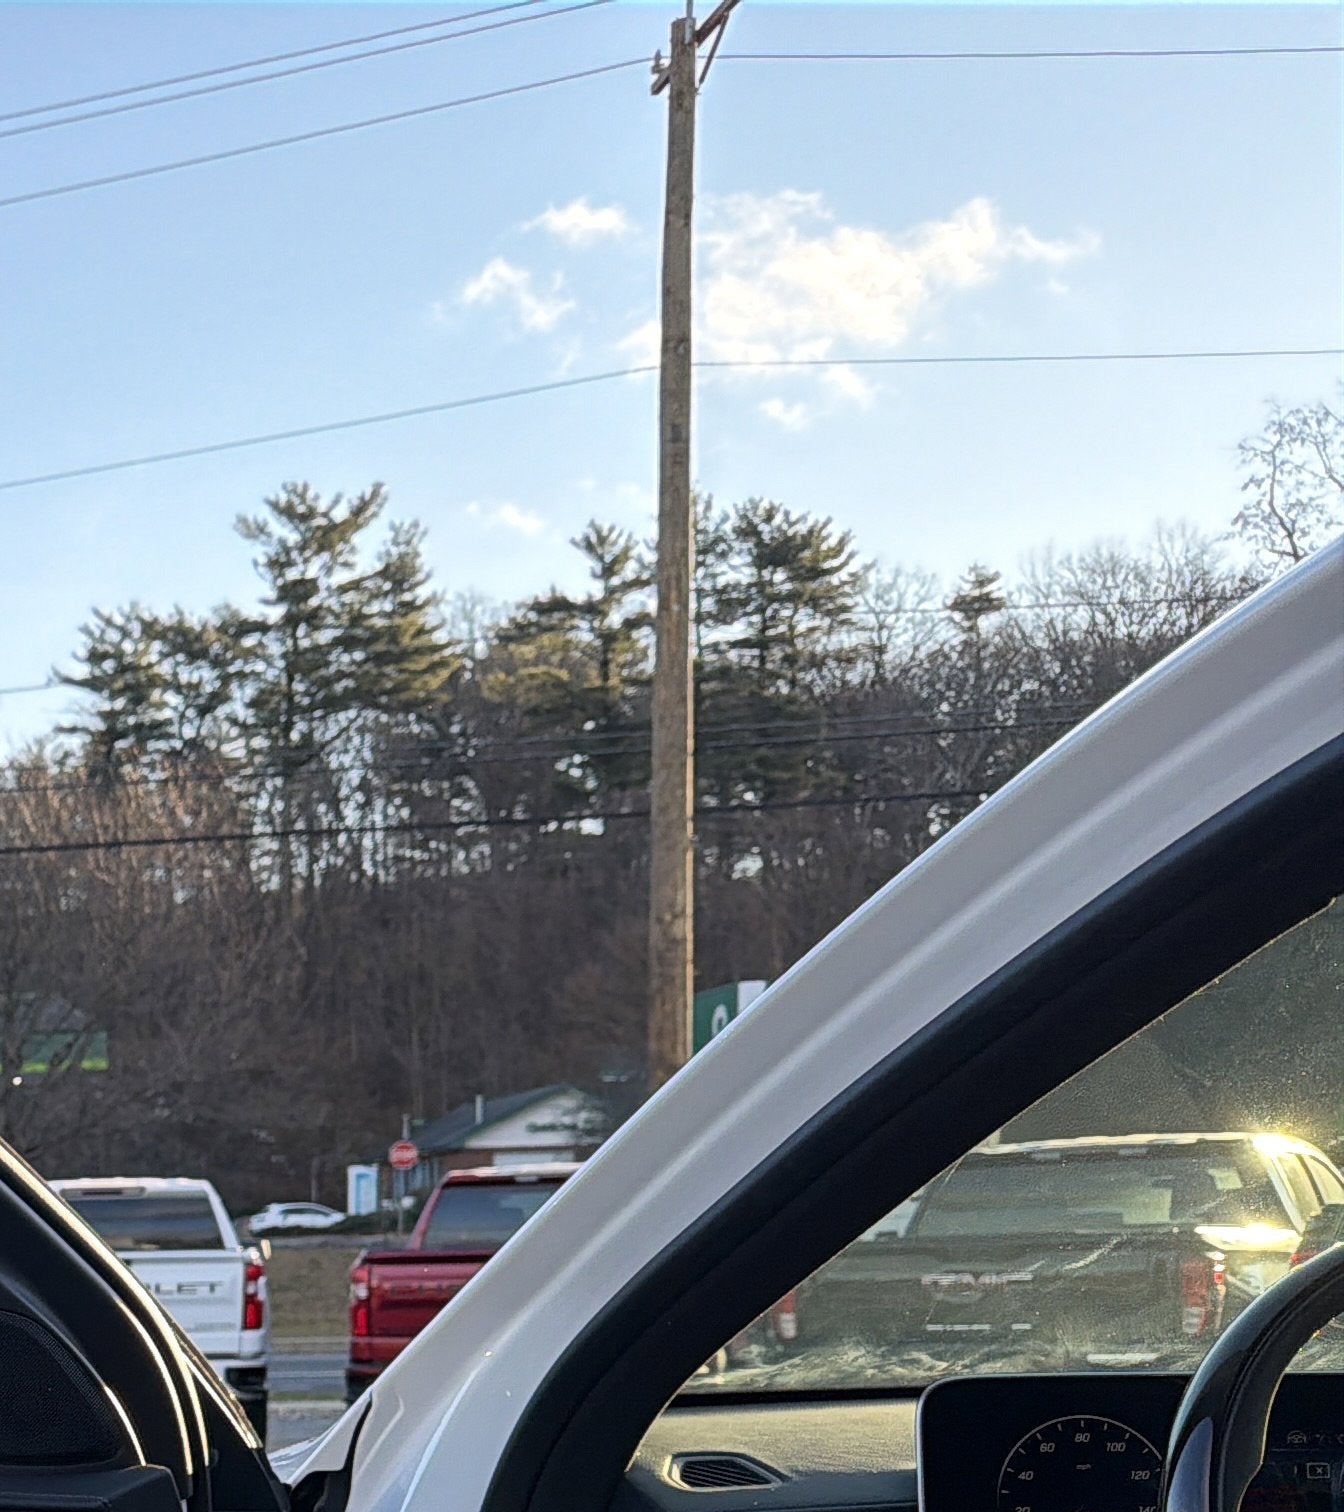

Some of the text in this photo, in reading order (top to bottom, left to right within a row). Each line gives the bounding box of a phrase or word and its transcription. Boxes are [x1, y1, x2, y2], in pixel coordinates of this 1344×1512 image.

[1074, 1432, 1091, 1443] 80
[1039, 1442, 1056, 1453] 60
[1106, 1442, 1126, 1452] 100
[1075, 1463, 1092, 1471] mph
[1017, 1470, 1034, 1480] 40
[1130, 1470, 1151, 1480] 120
